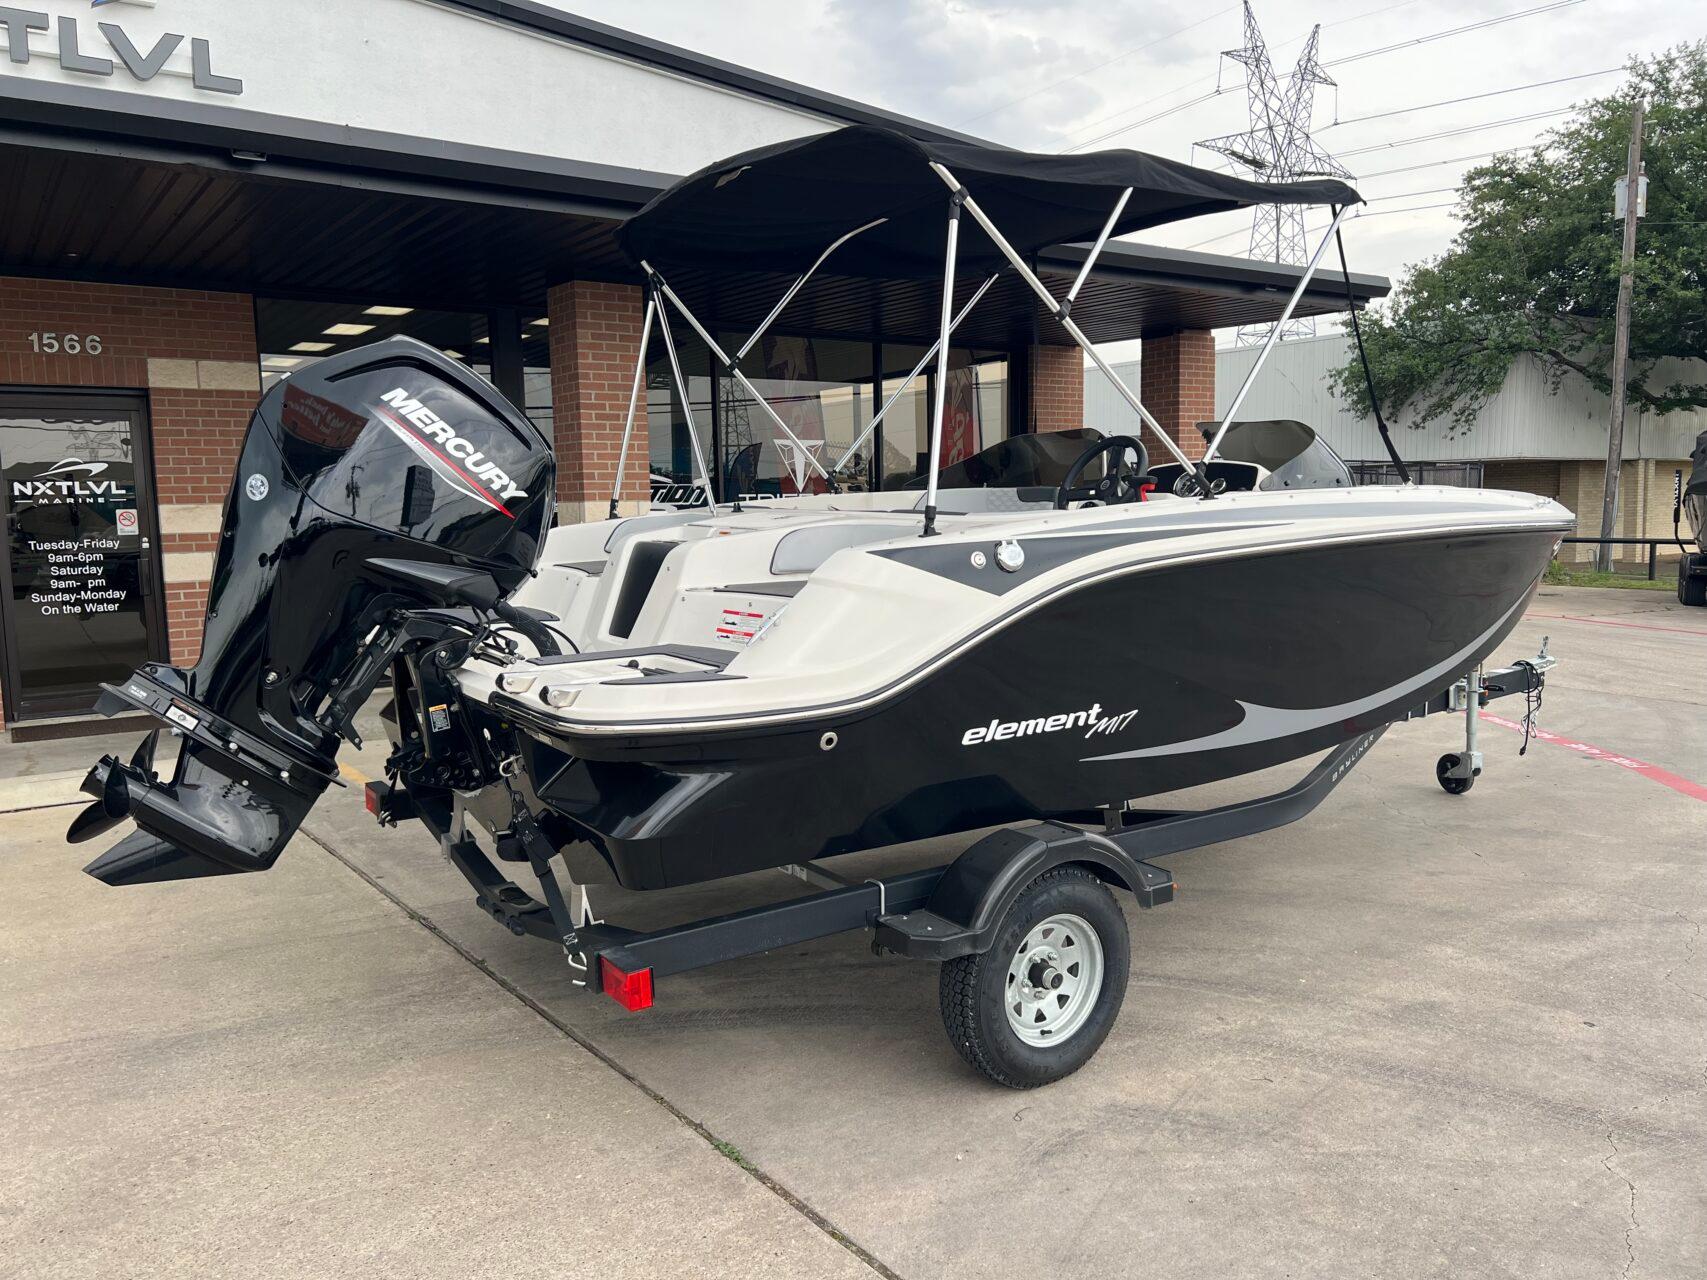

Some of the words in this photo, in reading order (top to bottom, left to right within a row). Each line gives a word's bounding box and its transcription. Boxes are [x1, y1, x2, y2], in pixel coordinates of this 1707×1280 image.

[28, 332, 102, 354] 1566
[380, 387, 528, 499] MERCURY
[13, 481, 126, 496] NXTLVL
[28, 539, 120, 551] Tuesday-Friday
[48, 552, 104, 563] 9am-6pm
[50, 566, 104, 576] Saturday
[31, 590, 127, 603] Sunday-Monday
[41, 605, 60, 616] On
[62, 604, 82, 614] the
[85, 602, 120, 613] Water
[961, 703, 1102, 746] element
[1084, 709, 1139, 739] M17
[1331, 733, 1375, 782] BAYLINER
